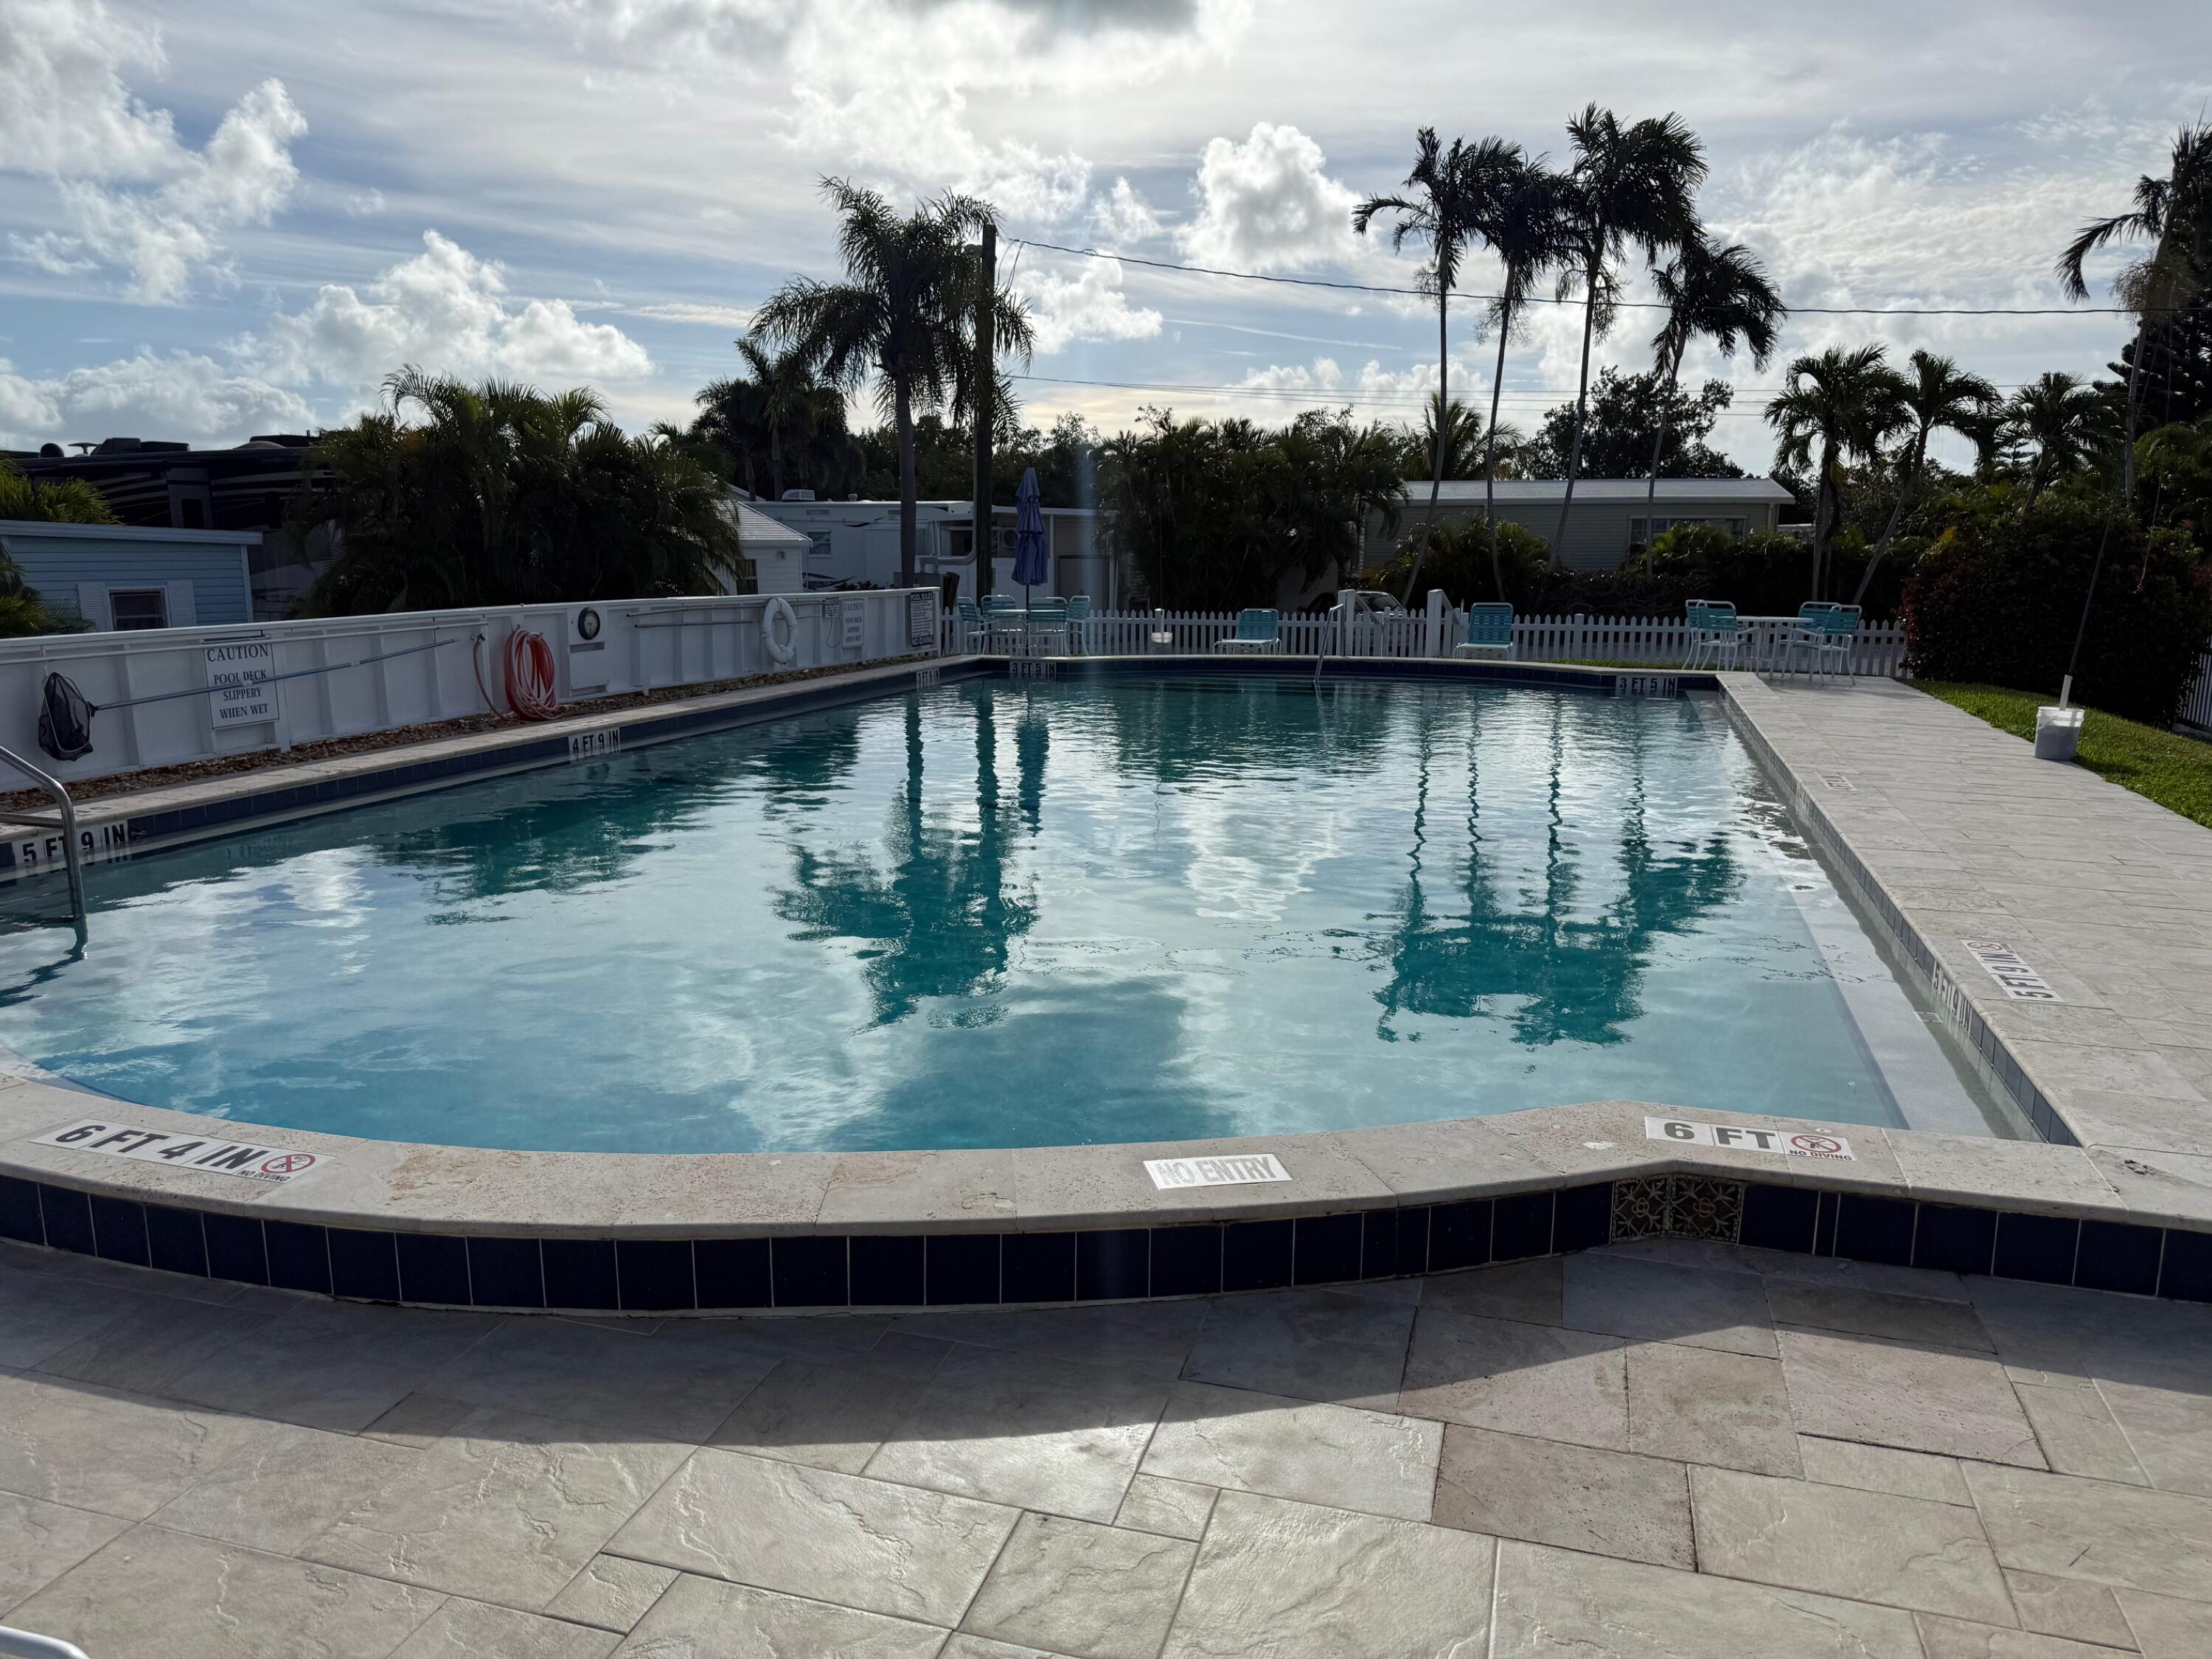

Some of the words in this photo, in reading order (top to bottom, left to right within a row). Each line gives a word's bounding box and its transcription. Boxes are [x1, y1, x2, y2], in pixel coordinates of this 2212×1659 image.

[844, 602, 863, 611] CAUTION
[207, 644, 268, 662] CAUTION
[1022, 663, 1032, 672] FT
[1046, 663, 1054, 673] IN
[214, 672, 240, 684] POOL
[243, 669, 266, 681] DECK
[1620, 677, 1627, 690] 3
[1632, 678, 1646, 690] FT
[1650, 678, 1658, 690] 5
[1663, 678, 1676, 692] IN
[223, 687, 261, 701] SLIPPERY
[220, 706, 248, 720] WHEN
[250, 703, 268, 715] WET
[573, 738, 579, 750] 4
[582, 734, 594, 750] FT
[598, 733, 605, 745] 9
[608, 729, 619, 744] IN
[22, 842, 37, 862] 5
[81, 831, 94, 850] 9
[104, 824, 126, 846] IN
[1978, 951, 2021, 964] IN
[1992, 965, 2029, 973] 9
[1998, 974, 2046, 989] FT
[1933, 961, 1941, 991] 5
[1941, 970, 1952, 1004] FT
[1952, 988, 1959, 1016] 9
[1959, 995, 1972, 1032] IN
[2012, 990, 2054, 999] 5
[1663, 1122, 1695, 1140] 6
[1716, 1127, 1777, 1150] FT
[55, 1124, 106, 1143] 6
[88, 1130, 172, 1153] FT
[158, 1141, 207, 1159] 4
[194, 1145, 270, 1169] IN
[1810, 1152, 1853, 1161] DIVING
[253, 1172, 291, 1181] DIVING
[1154, 1161, 1196, 1186] NO
[1194, 1156, 1277, 1183] ENTRY
